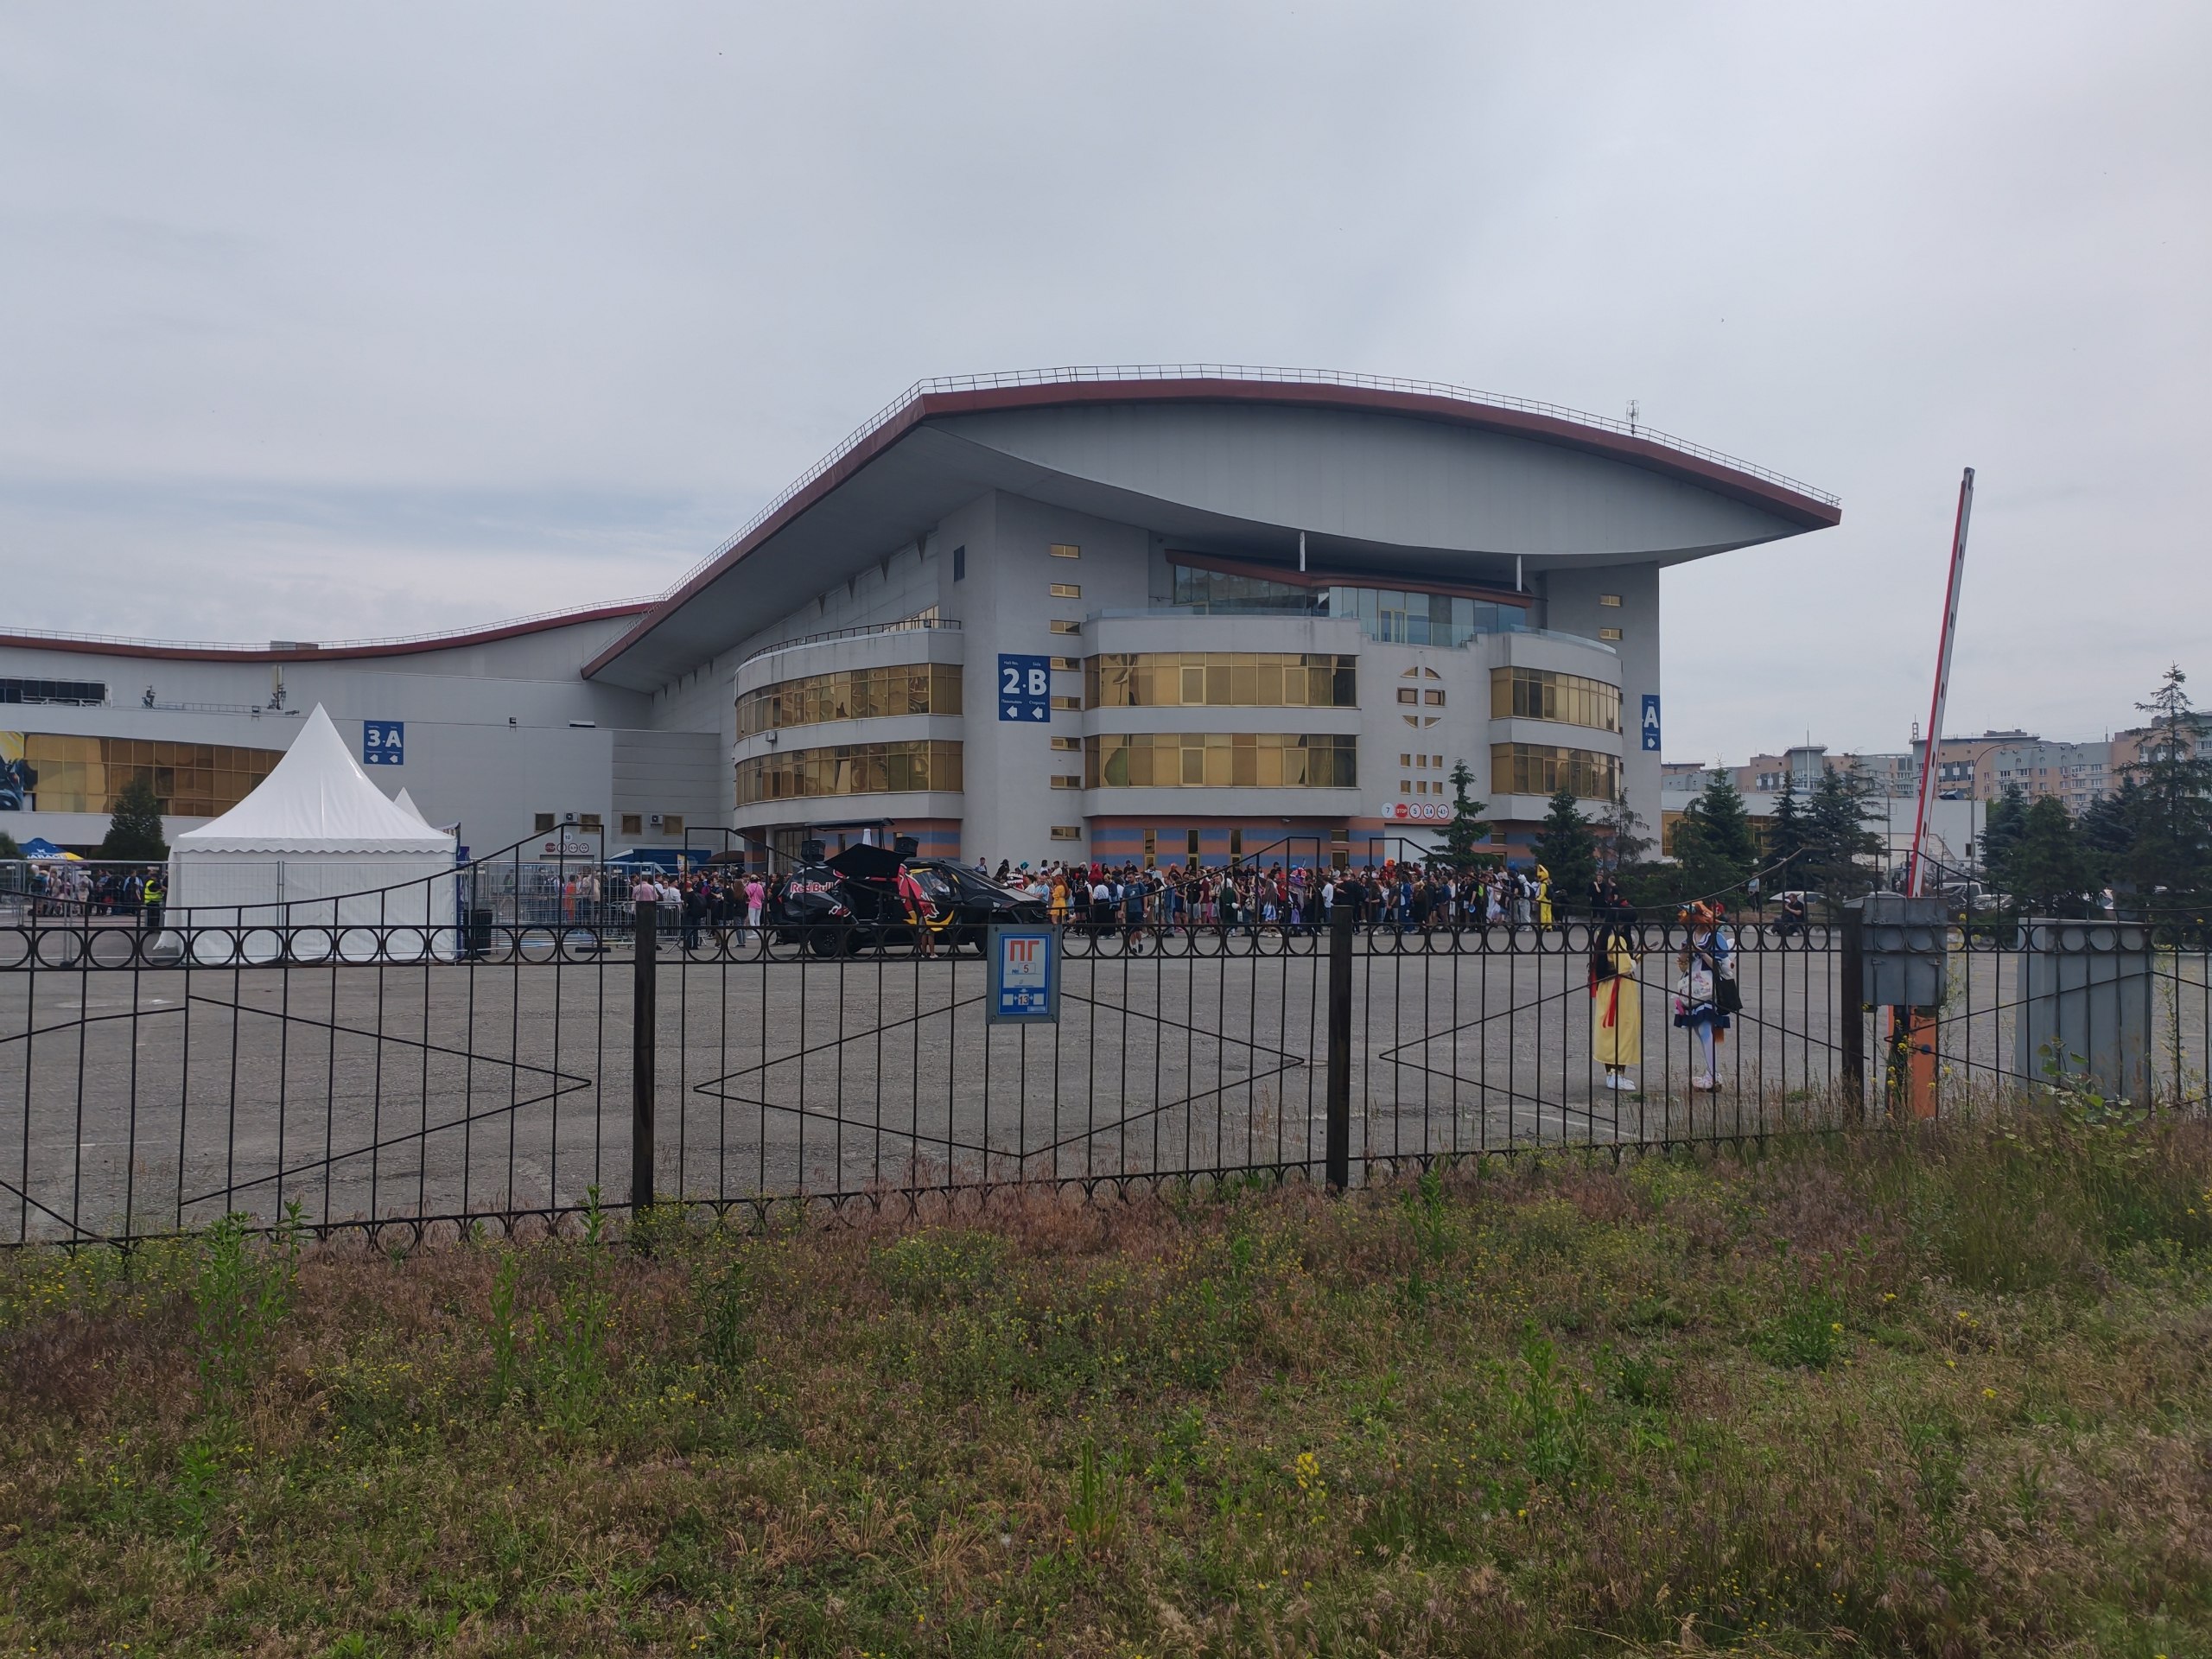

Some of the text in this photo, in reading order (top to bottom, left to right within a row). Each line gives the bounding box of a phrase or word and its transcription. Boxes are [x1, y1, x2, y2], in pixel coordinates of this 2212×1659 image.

[1643, 706, 1659, 728] A
[791, 881, 834, 893] Red Bull
[1009, 940, 1039, 962] ПГ
[1023, 964, 1029, 974] 5
[1019, 995, 1029, 1005] 13
